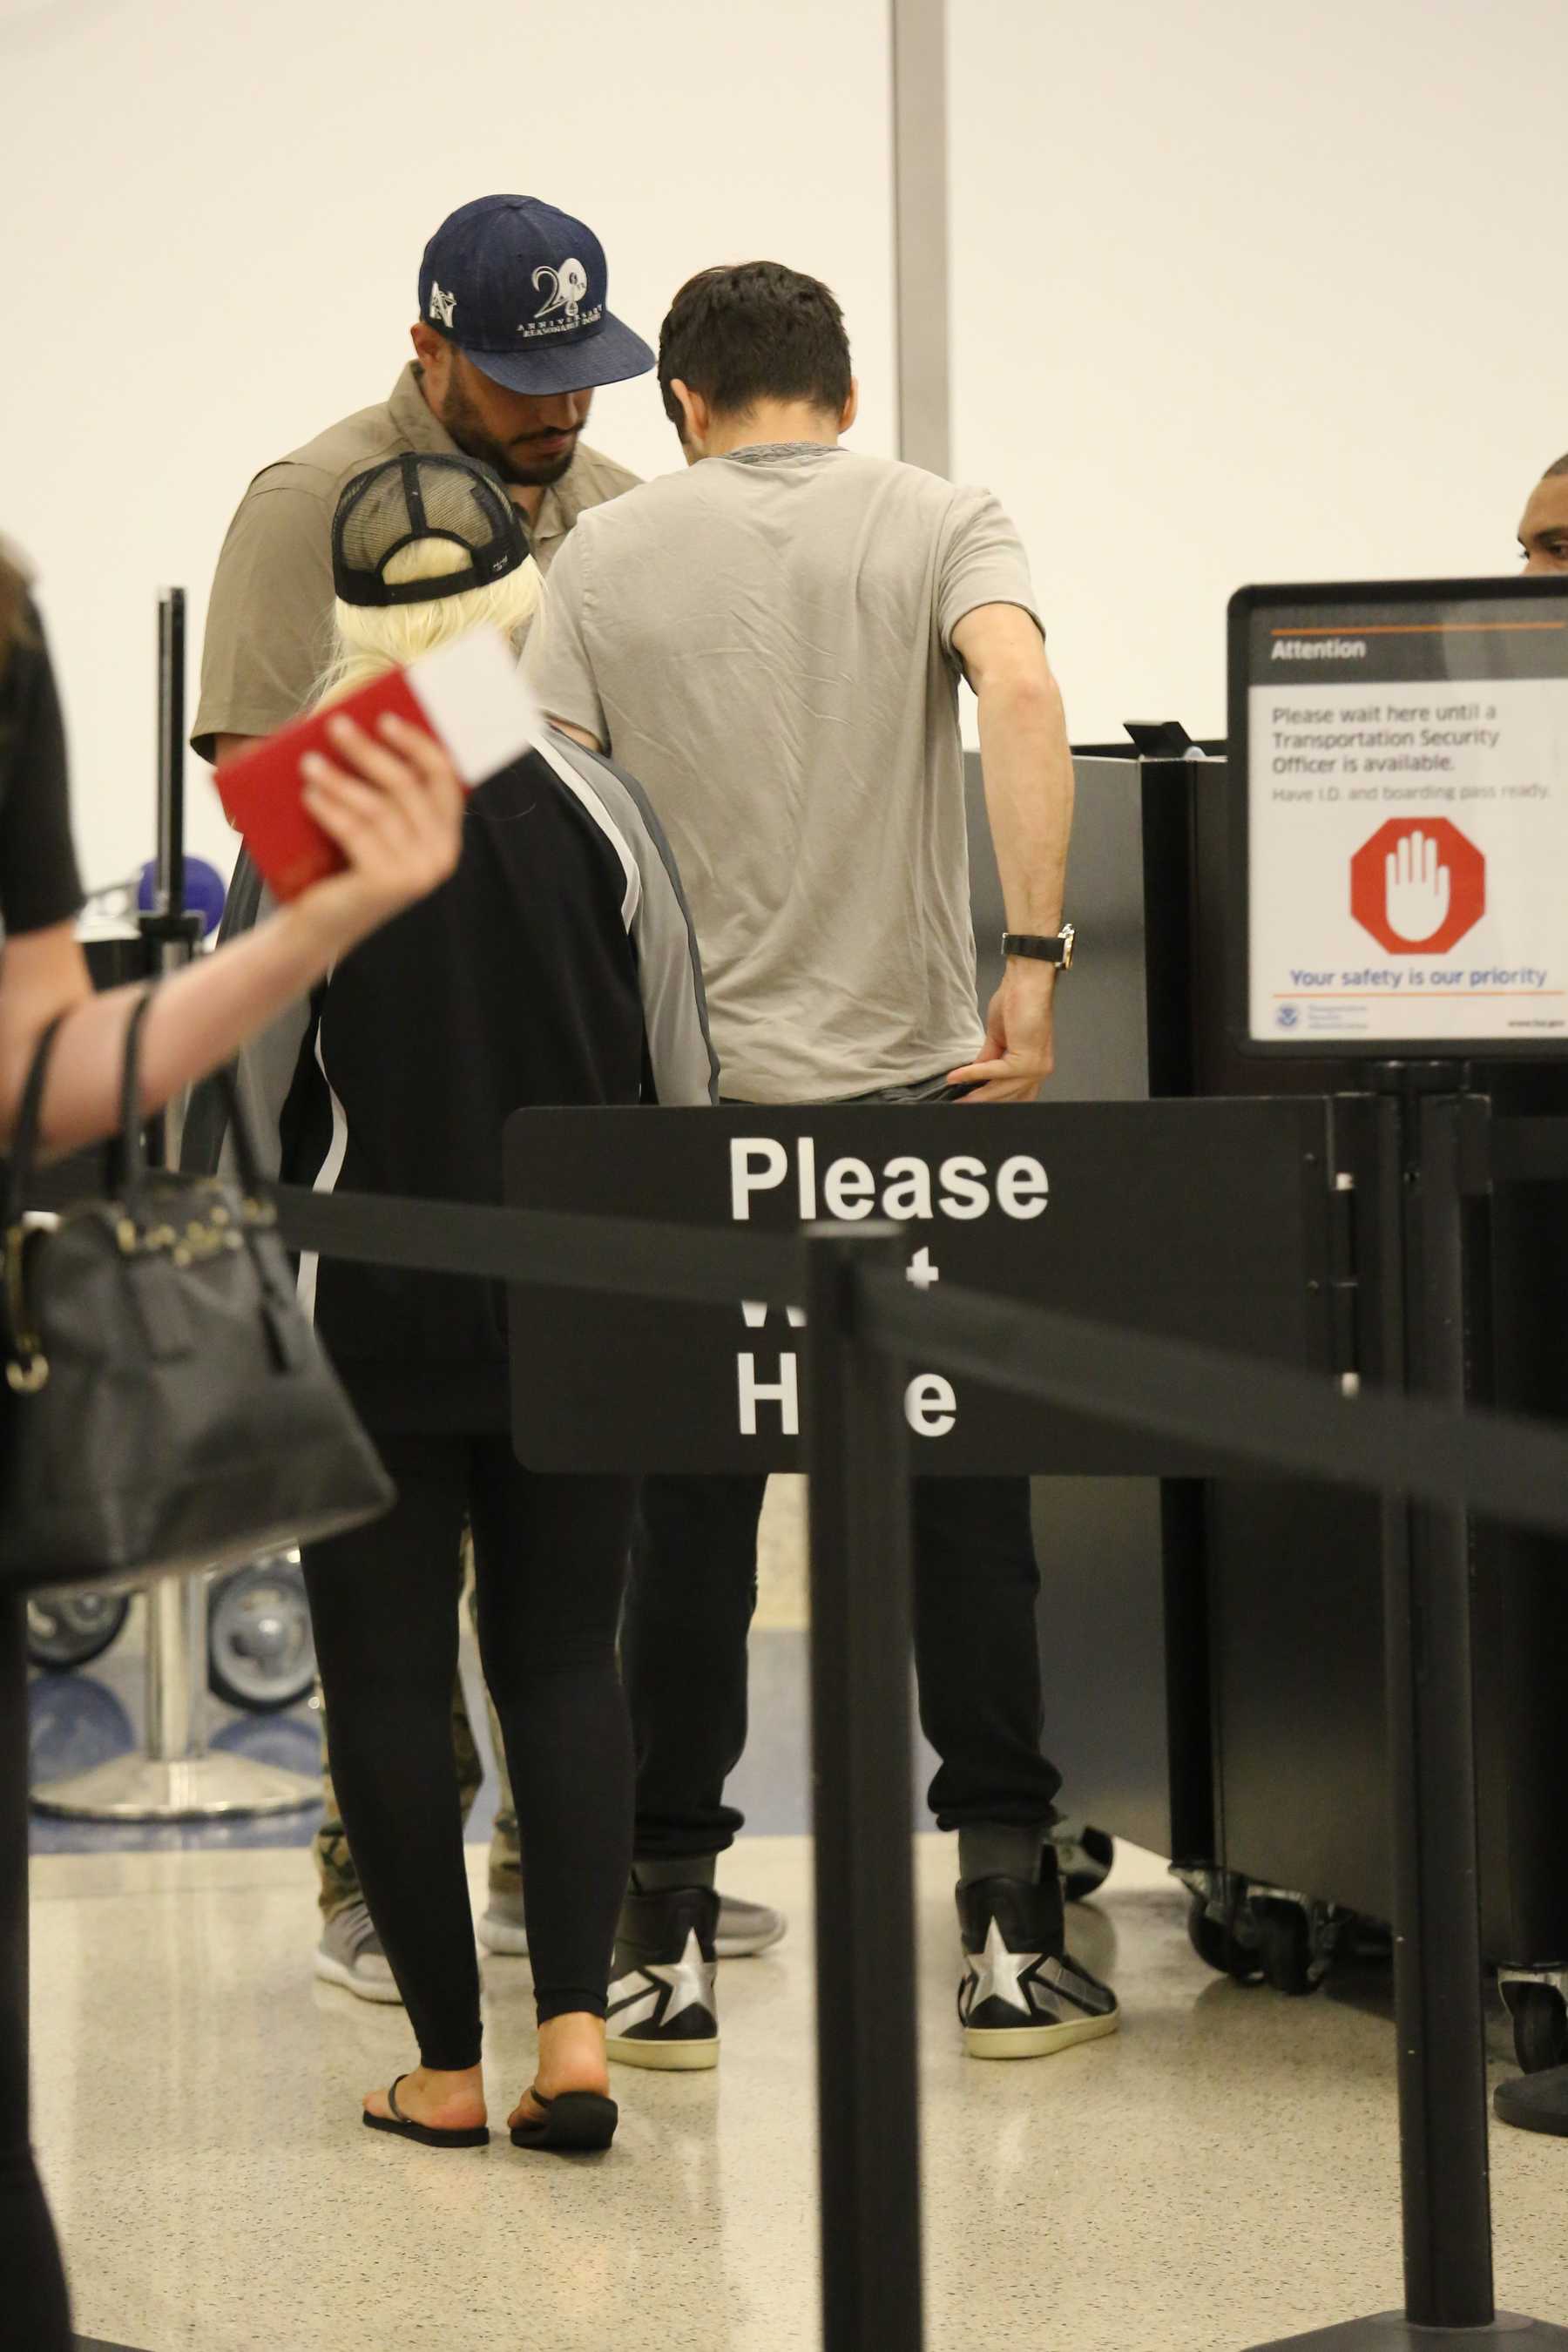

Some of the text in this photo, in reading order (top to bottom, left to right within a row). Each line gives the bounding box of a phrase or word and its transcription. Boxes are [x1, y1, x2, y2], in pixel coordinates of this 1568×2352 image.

[1271, 639, 1366, 660] Attention
[1273, 704, 1497, 724] Please wait here until a
[1273, 728, 1500, 750] Transportation Security
[1273, 754, 1455, 774] Officer is available.
[1272, 787, 1313, 801] Have
[1348, 787, 1378, 801] and
[1382, 785, 1456, 802] boarding
[1460, 786, 1497, 801] pass
[1290, 966, 1547, 988] Your safety is our priority
[730, 1137, 1049, 1220] Please
[738, 1352, 956, 1437] He
